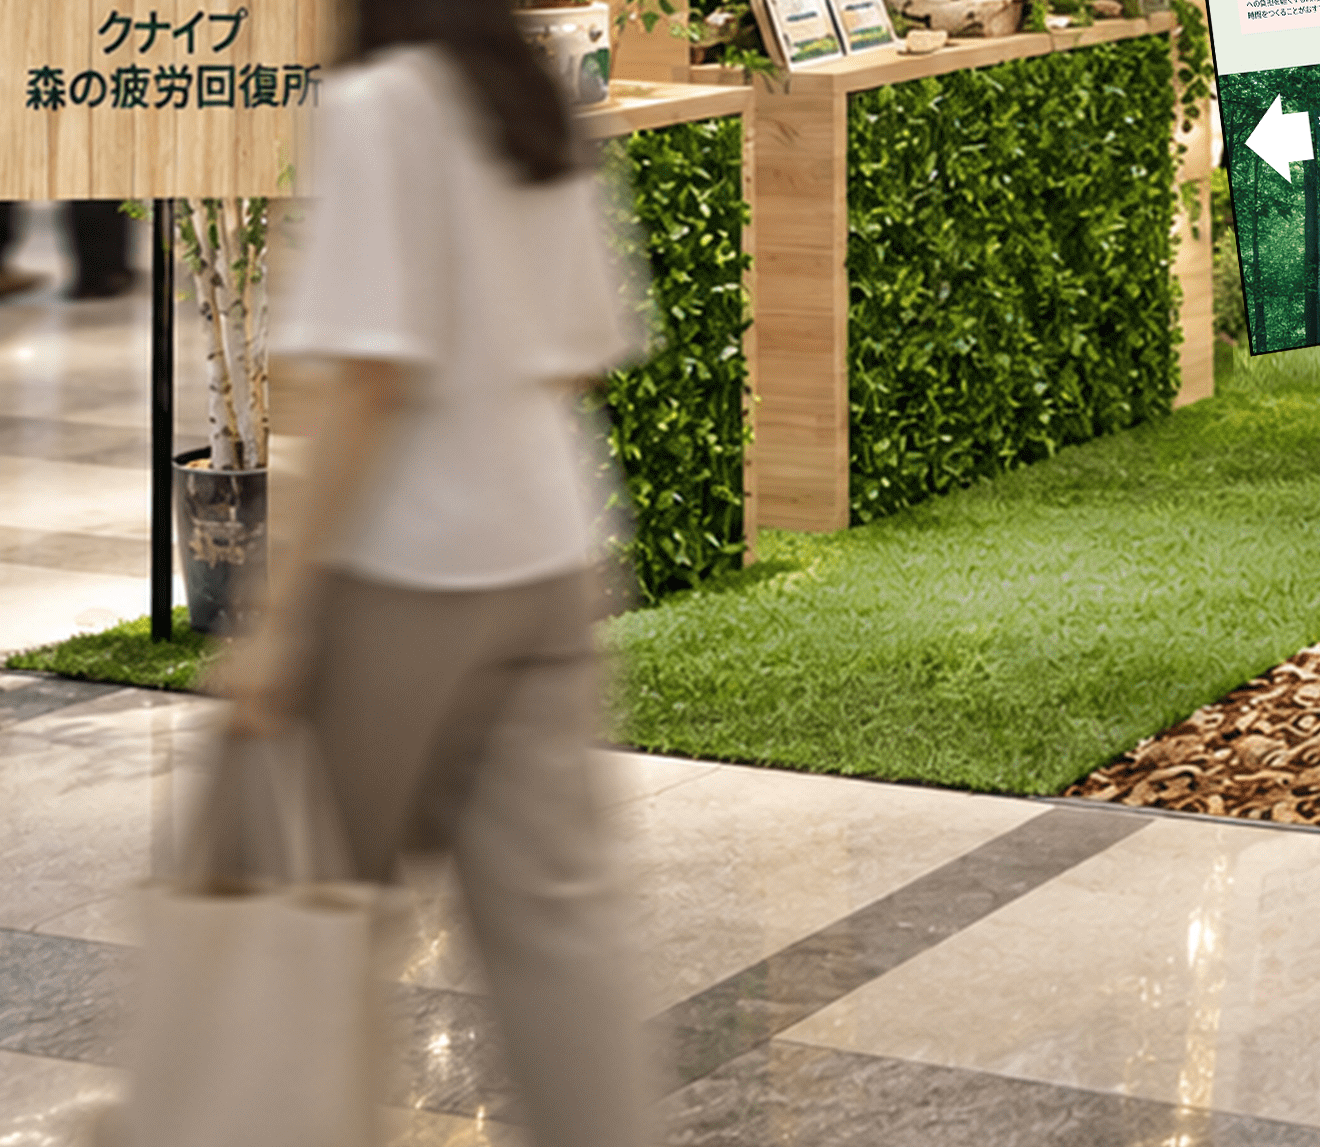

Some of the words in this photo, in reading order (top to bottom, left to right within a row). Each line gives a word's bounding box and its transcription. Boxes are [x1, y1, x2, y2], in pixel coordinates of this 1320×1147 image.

[98, 6, 249, 54] クナイプ
[26, 63, 323, 111] 森の疲労回復所
